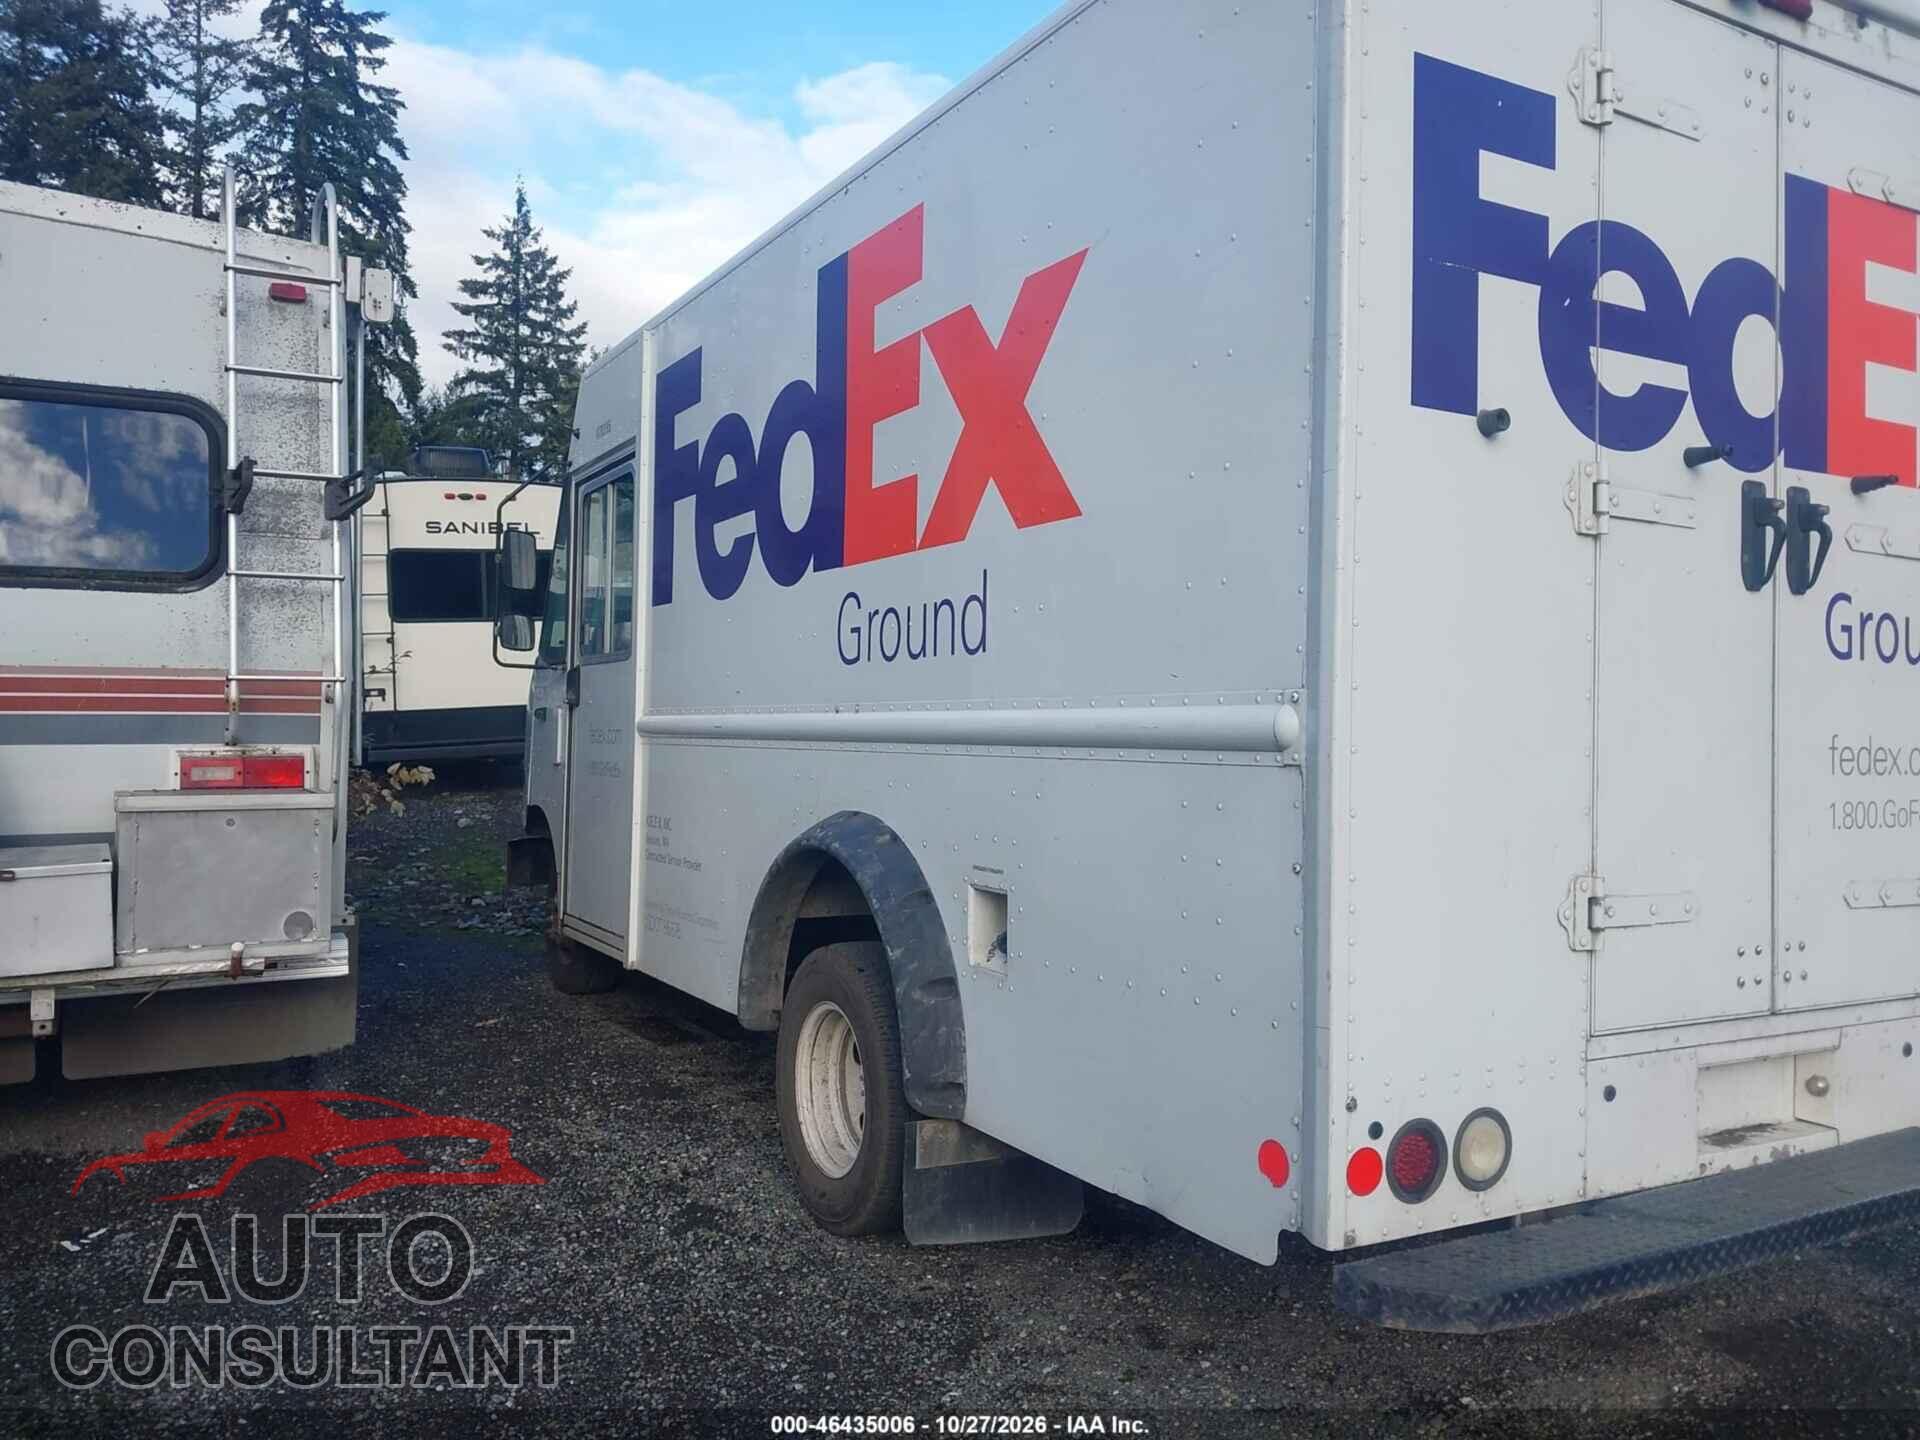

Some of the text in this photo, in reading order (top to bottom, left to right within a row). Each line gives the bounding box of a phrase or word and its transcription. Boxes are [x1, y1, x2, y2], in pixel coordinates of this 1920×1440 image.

[1410, 50, 1920, 489] FedE
[651, 201, 1091, 607] FedEx
[425, 521, 541, 535] SANIBEL
[837, 568, 988, 666] Ground
[1829, 799, 1920, 830] 1.800.GoF
